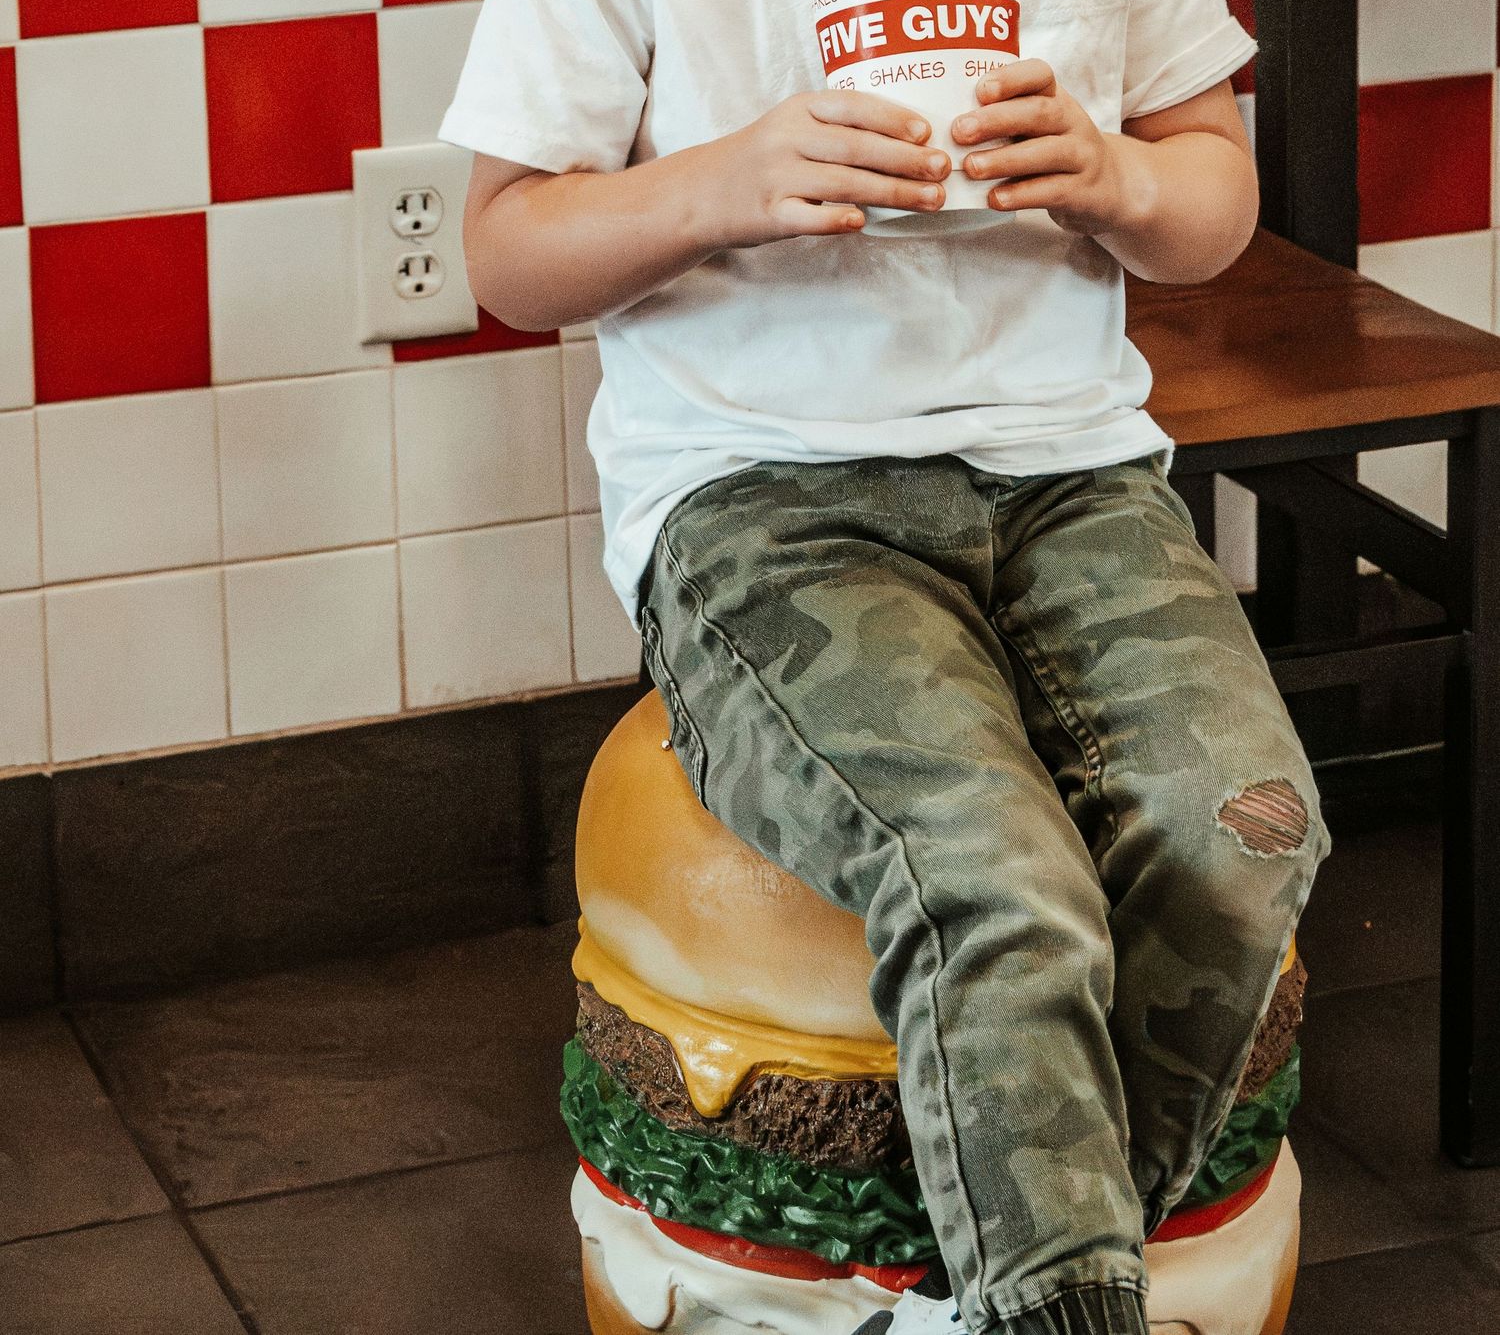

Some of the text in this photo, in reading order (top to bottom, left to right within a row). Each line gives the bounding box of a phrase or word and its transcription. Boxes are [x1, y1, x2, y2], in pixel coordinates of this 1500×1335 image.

[819, 4, 1010, 64] FIVE GUYS
[870, 61, 945, 87] SHAKES
